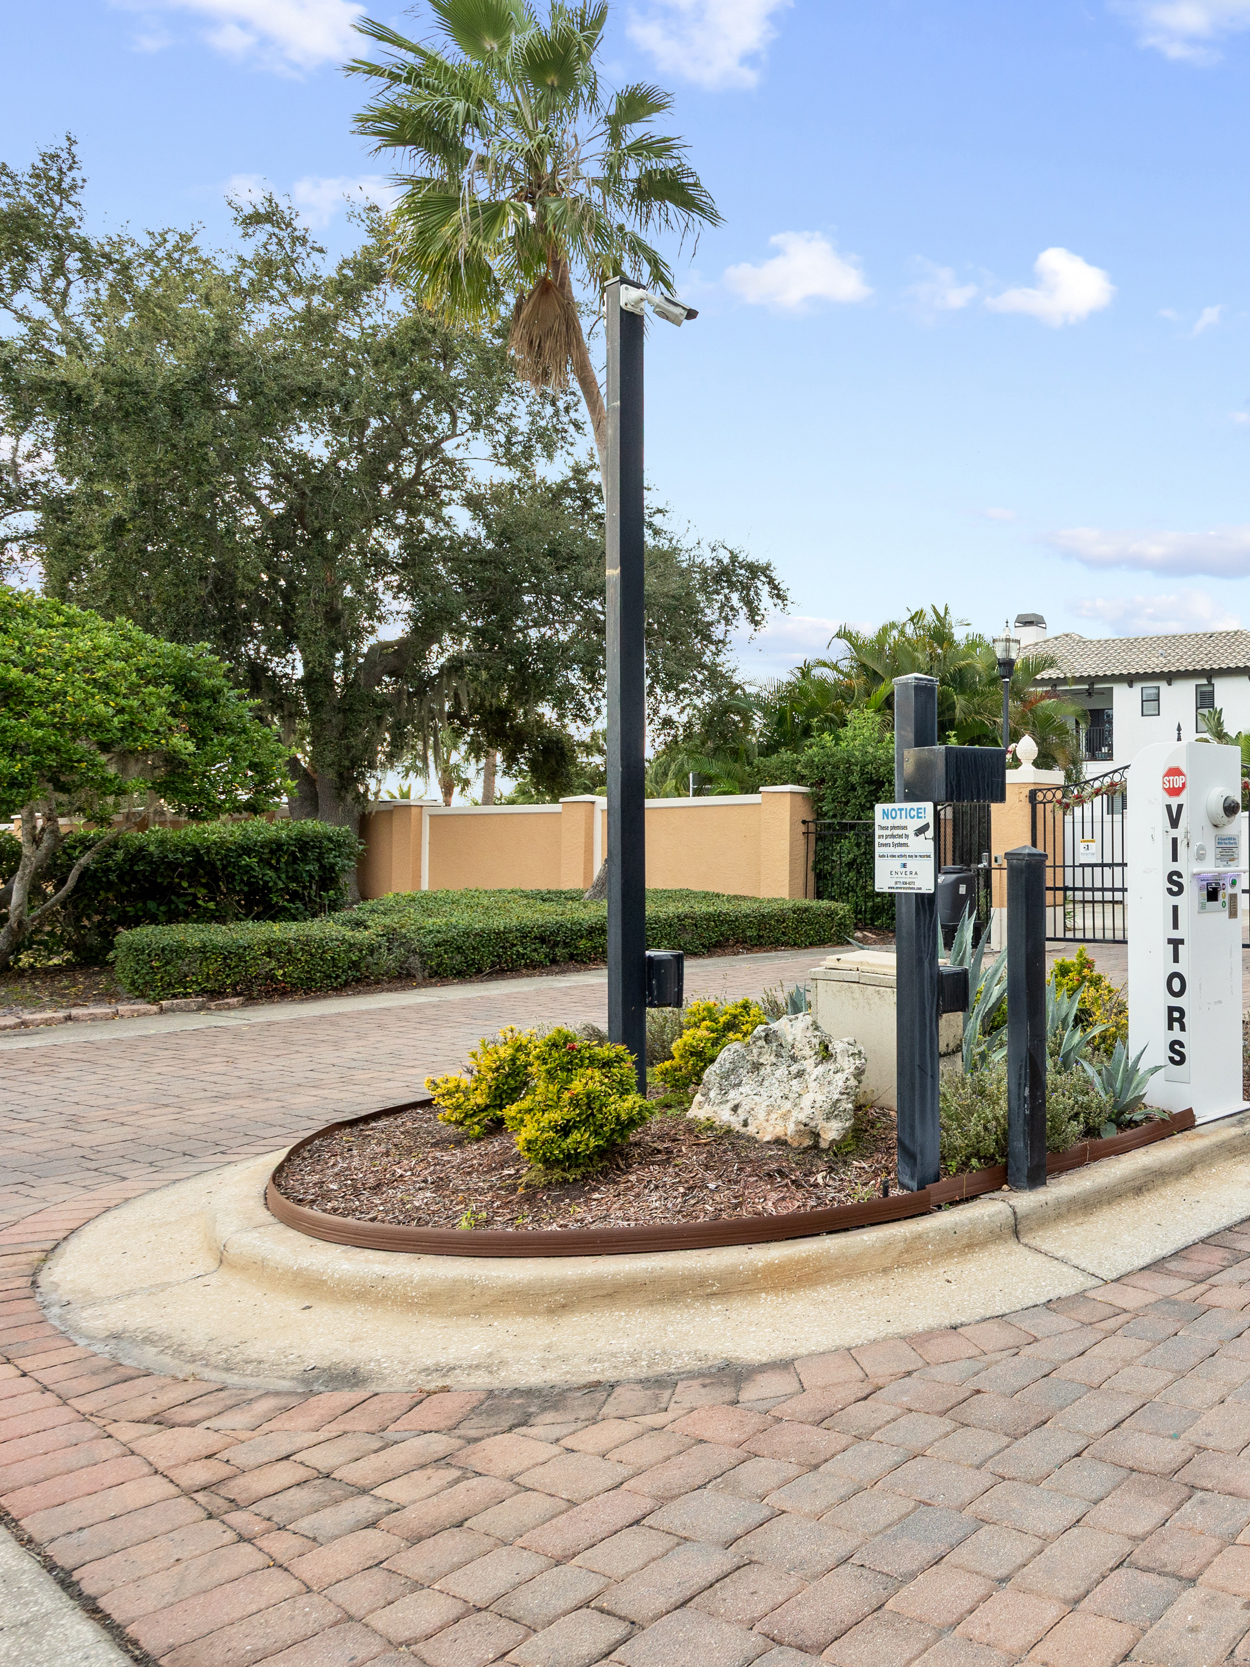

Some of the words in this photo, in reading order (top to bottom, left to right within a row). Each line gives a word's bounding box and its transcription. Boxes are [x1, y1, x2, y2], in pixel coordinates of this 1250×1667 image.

[1163, 776, 1186, 788] STOP
[882, 807, 926, 820] NOTICE!
[1165, 803, 1187, 1067] VISITORS
